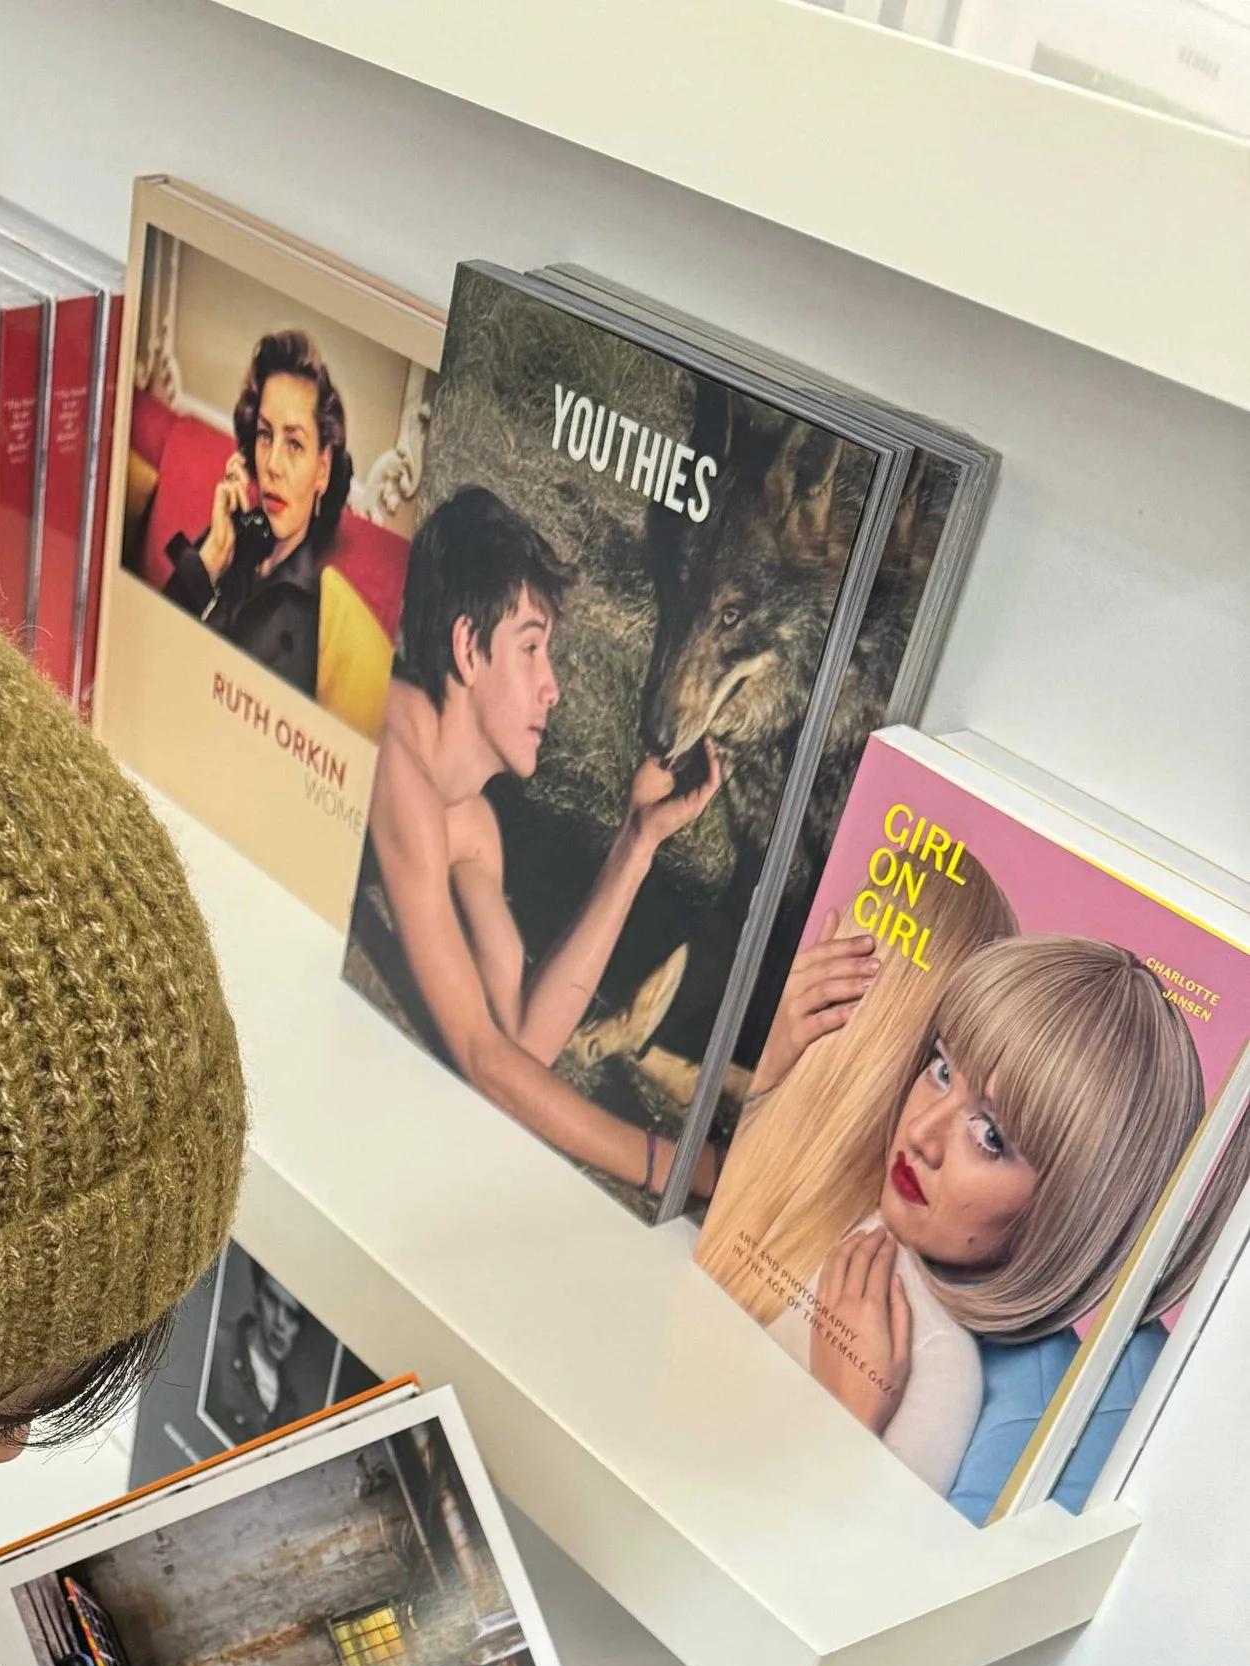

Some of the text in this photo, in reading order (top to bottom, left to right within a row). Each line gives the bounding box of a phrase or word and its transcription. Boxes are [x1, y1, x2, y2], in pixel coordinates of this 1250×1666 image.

[552, 384, 717, 523] YOUTHIES
[213, 671, 347, 790] RUTH ORKIN
[304, 772, 364, 838] WOME
[884, 804, 966, 886] GIRL
[869, 847, 927, 908] ON
[854, 890, 931, 972] GIRL
[1145, 957, 1220, 1006] CHARLOTTE
[1162, 989, 1211, 1022] JANSEN
[732, 1245, 744, 1259] IN
[745, 1258, 764, 1278] THE
[766, 1276, 785, 1299] AGE
[787, 1298, 801, 1311] OF
[802, 1310, 824, 1336] THE
[825, 1329, 868, 1373] FEMALE
[737, 1230, 859, 1342] ART AND PHOTOGRAPHY
